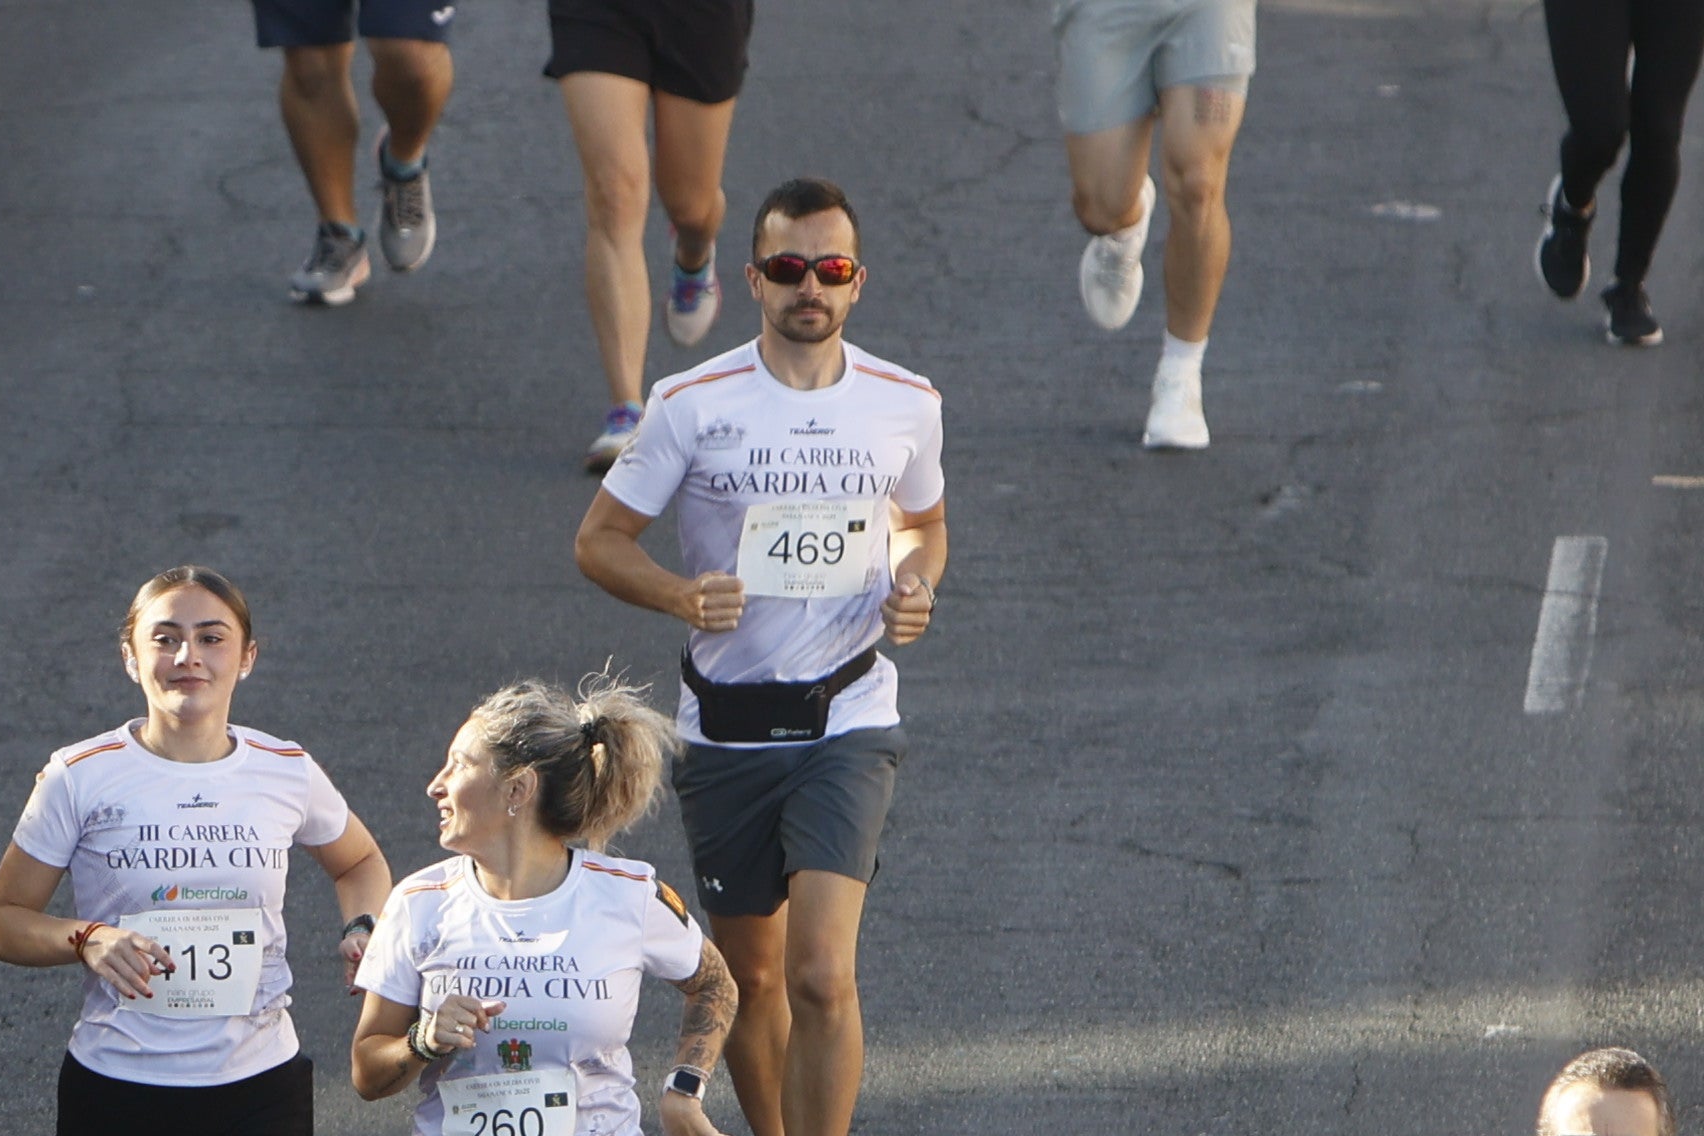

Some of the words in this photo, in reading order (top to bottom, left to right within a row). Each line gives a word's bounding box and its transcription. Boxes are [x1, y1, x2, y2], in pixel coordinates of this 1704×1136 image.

[749, 448, 771, 466] III
[780, 449, 876, 468] CARRERA
[710, 472, 828, 495] GVARDIA
[767, 530, 845, 565] 469
[139, 824, 160, 841] III
[168, 824, 260, 842] CARRERA
[106, 847, 217, 870] GVARDIA
[181, 885, 248, 902] Iberdrola
[456, 955, 477, 970] III
[484, 955, 580, 973] CARRERA
[545, 978, 613, 1001] CIVIL
[493, 1017, 568, 1032] Iberdrola
